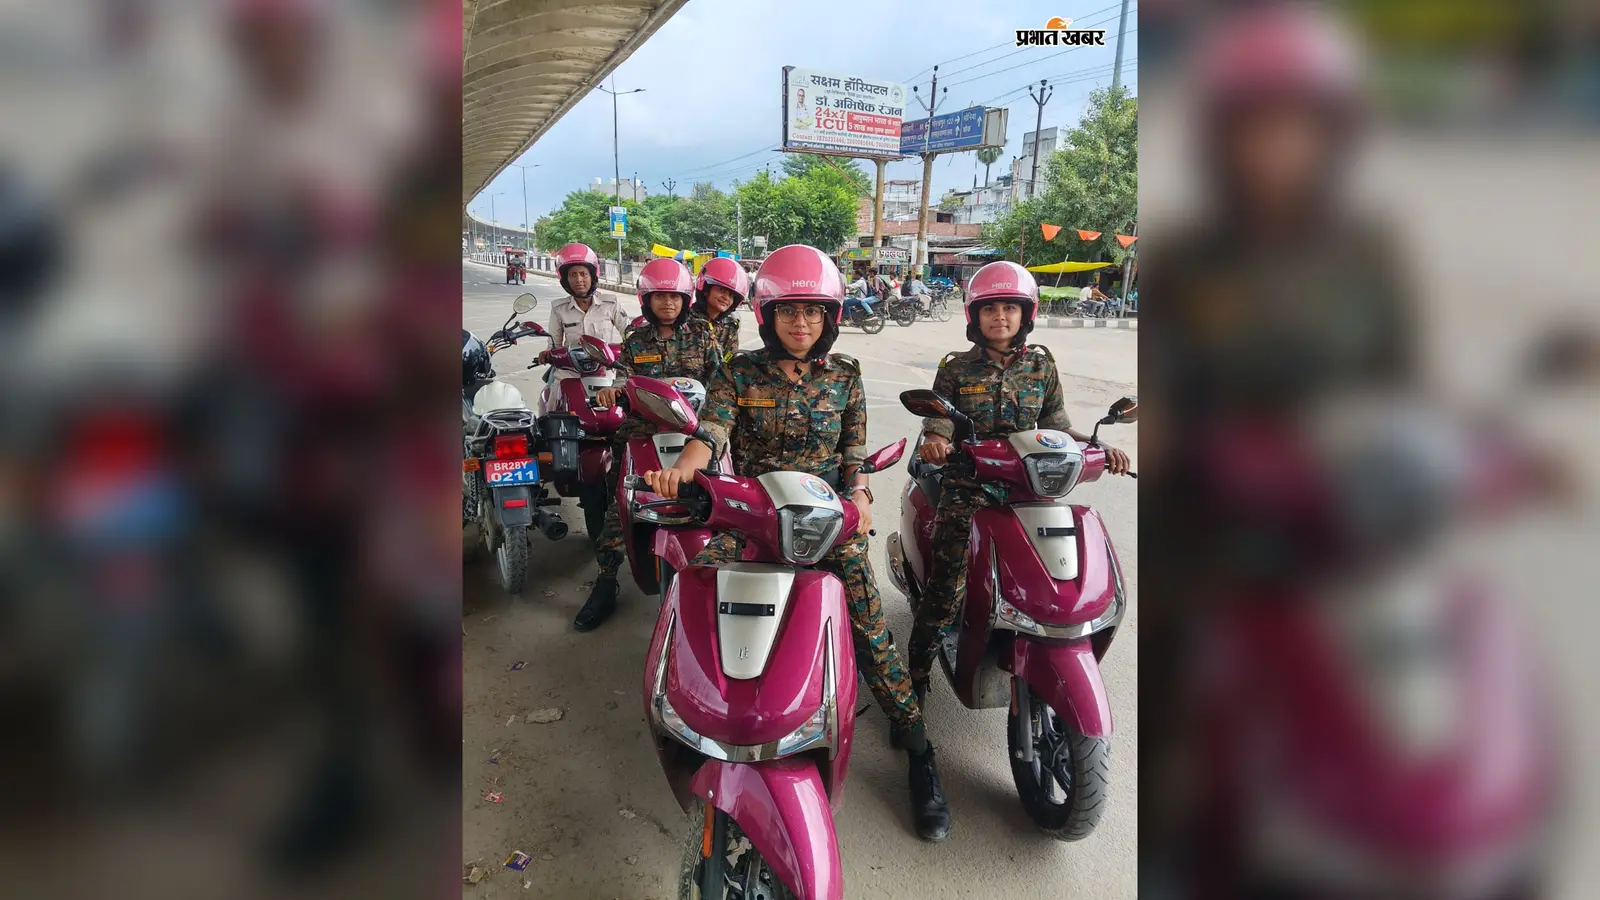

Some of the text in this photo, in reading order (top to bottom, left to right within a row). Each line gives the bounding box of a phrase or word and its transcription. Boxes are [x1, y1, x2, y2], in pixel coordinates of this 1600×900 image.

[811, 75, 841, 88] सक्षम
[844, 78, 888, 96] हॉस्पिटल
[833, 97, 875, 113] अभिषेक
[878, 103, 902, 116] रंजन
[815, 117, 845, 131] ICU
[848, 122, 853, 130] 5
[792, 279, 817, 288] Hero
[493, 460, 529, 471] BR28Y
[490, 470, 534, 482] 0211
